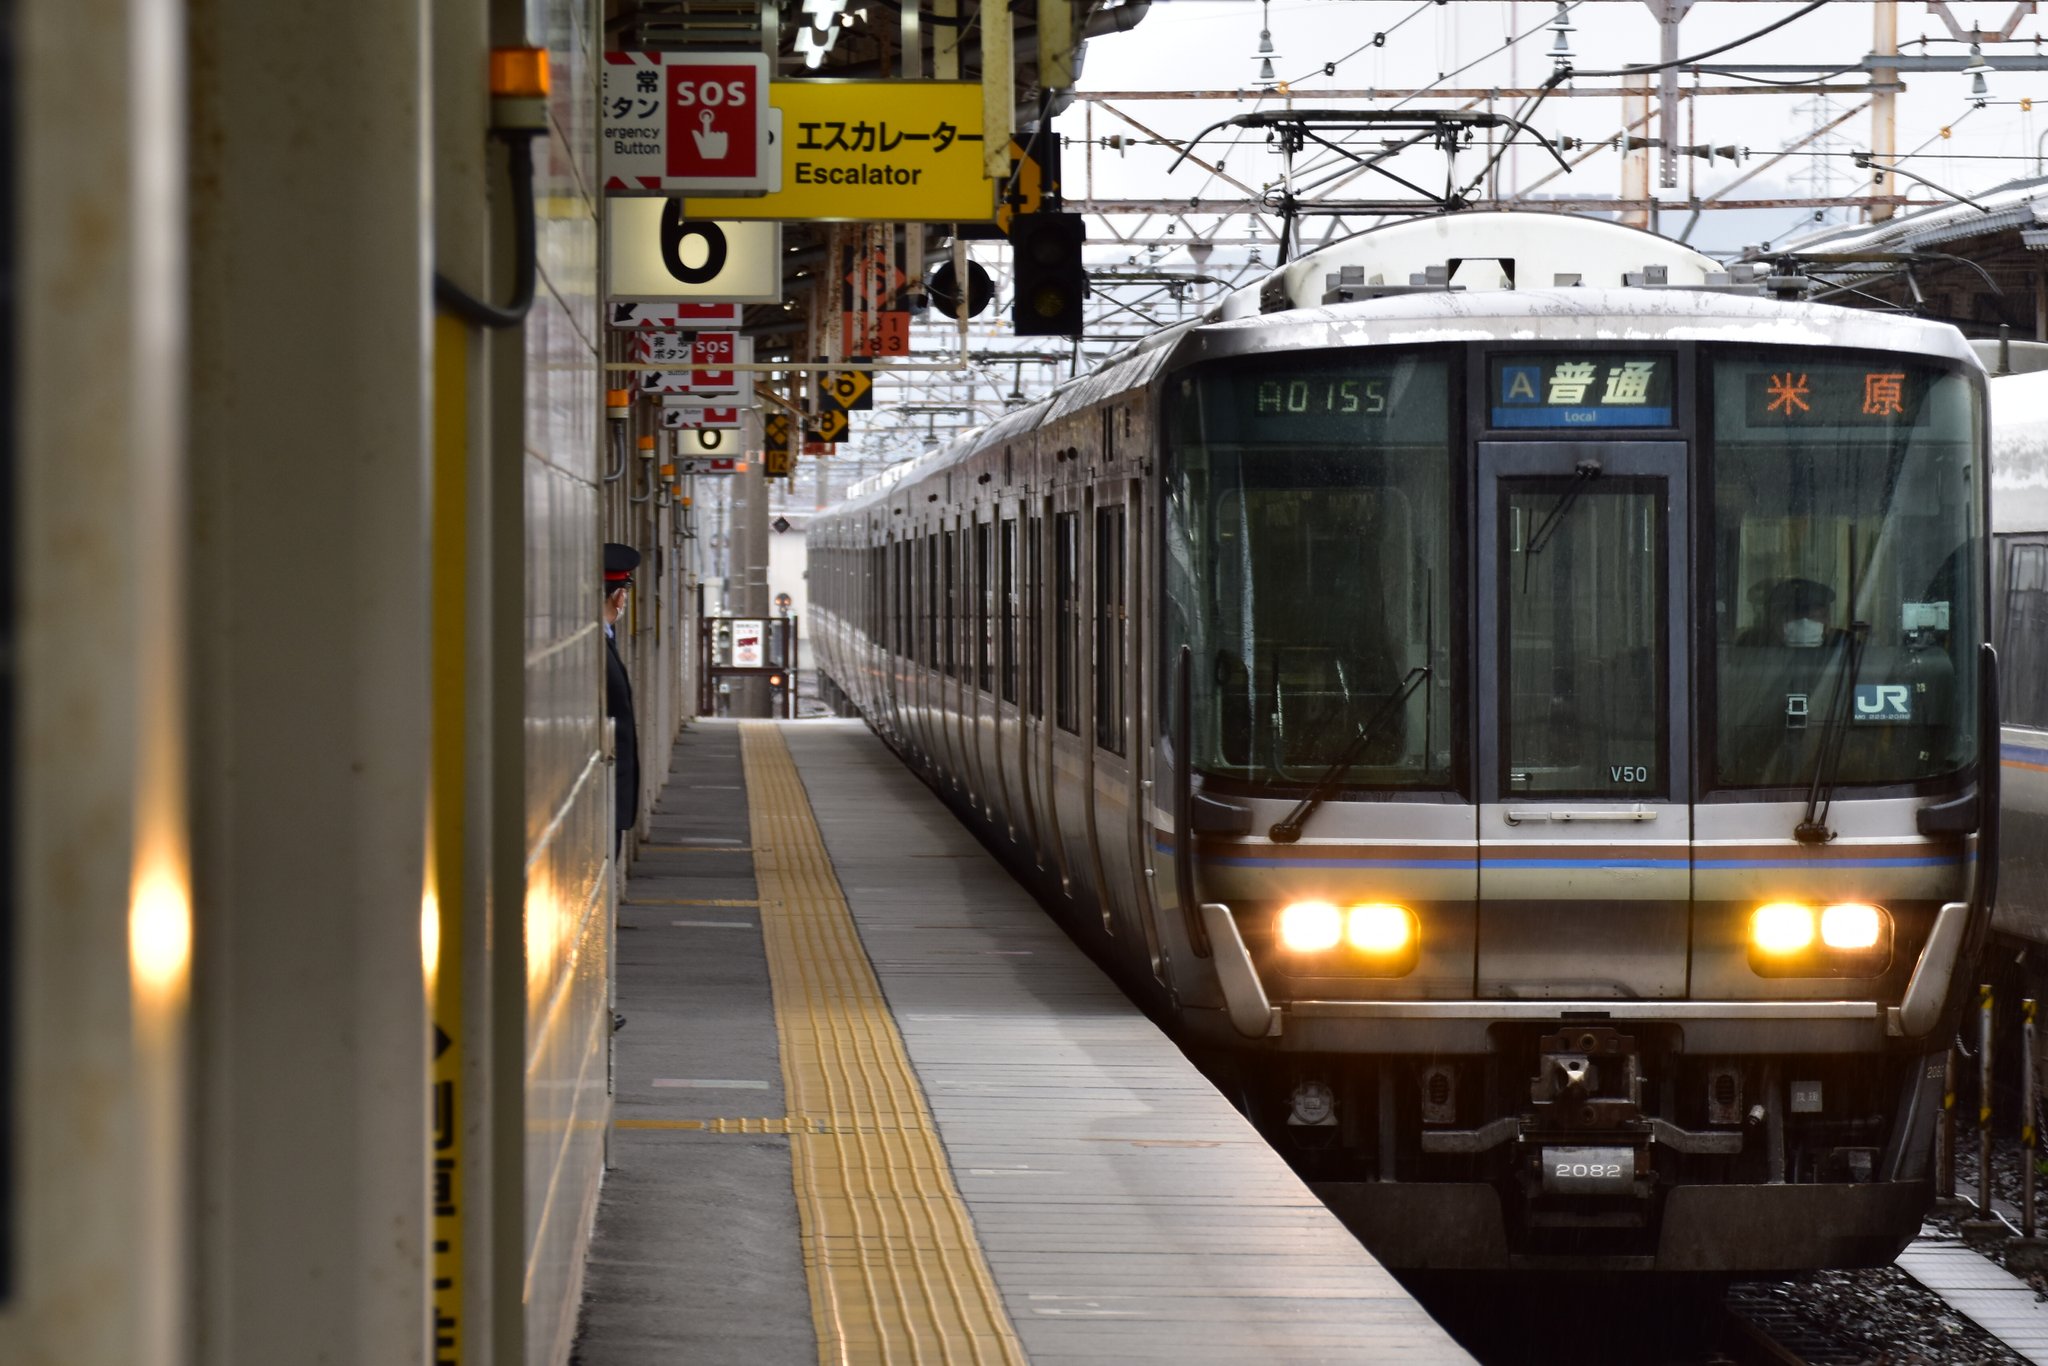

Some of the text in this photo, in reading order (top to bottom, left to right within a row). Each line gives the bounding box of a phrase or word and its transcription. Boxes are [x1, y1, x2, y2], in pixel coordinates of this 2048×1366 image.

[676, 81, 747, 107] SOS
[604, 127, 660, 139] ergency
[796, 120, 983, 153] エスカレーター
[614, 141, 660, 154] Button
[795, 162, 922, 185] Escalator
[660, 197, 727, 284] 6
[653, 348, 689, 360] ボタン
[695, 340, 730, 354] SOS
[1508, 361, 1656, 404] A 普通
[1767, 372, 1906, 416] 米原
[1564, 411, 1597, 423] Local
[1857, 685, 1908, 713] JR
[1610, 766, 1647, 783] V50
[1556, 1164, 1621, 1177] 2082
